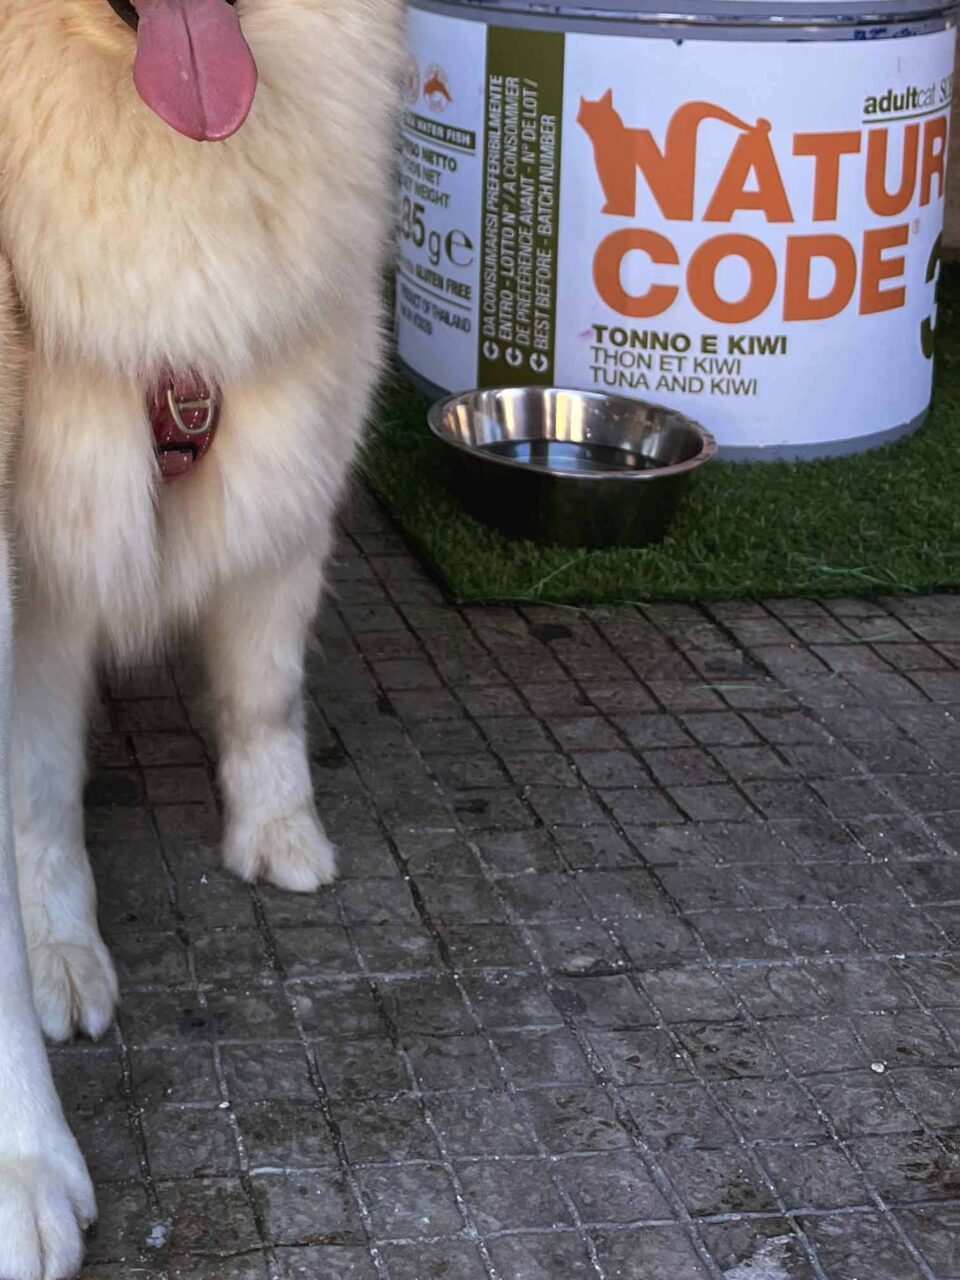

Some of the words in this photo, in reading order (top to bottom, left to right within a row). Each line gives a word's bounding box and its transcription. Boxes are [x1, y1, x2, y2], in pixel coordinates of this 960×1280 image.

[522, 88, 538, 118] LOT
[446, 129, 471, 146] FISH
[502, 76, 520, 178] CONSOMMER
[521, 120, 537, 142] DE
[422, 147, 457, 172] NETTO
[539, 114, 556, 183] NUMBER
[519, 175, 535, 225] AVANT
[537, 183, 554, 236] BATCH
[500, 226, 516, 278] LOTTO
[446, 277, 472, 301] FREE
[517, 226, 533, 325] PREFERENCE
[535, 248, 552, 308] BEFORE
[592, 224, 910, 324] CODE
[498, 289, 513, 341] ENTRO
[515, 324, 530, 346] DE
[533, 310, 550, 350] BEST
[591, 323, 691, 353] TONNO
[700, 334, 718, 354] E
[728, 334, 787, 355] KIWI
[589, 365, 650, 390] TUNA
[655, 375, 704, 394] AND
[710, 376, 758, 396] KIWI
[590, 345, 652, 370] THON
[659, 354, 688, 372] ET
[693, 356, 743, 376] KIWI
